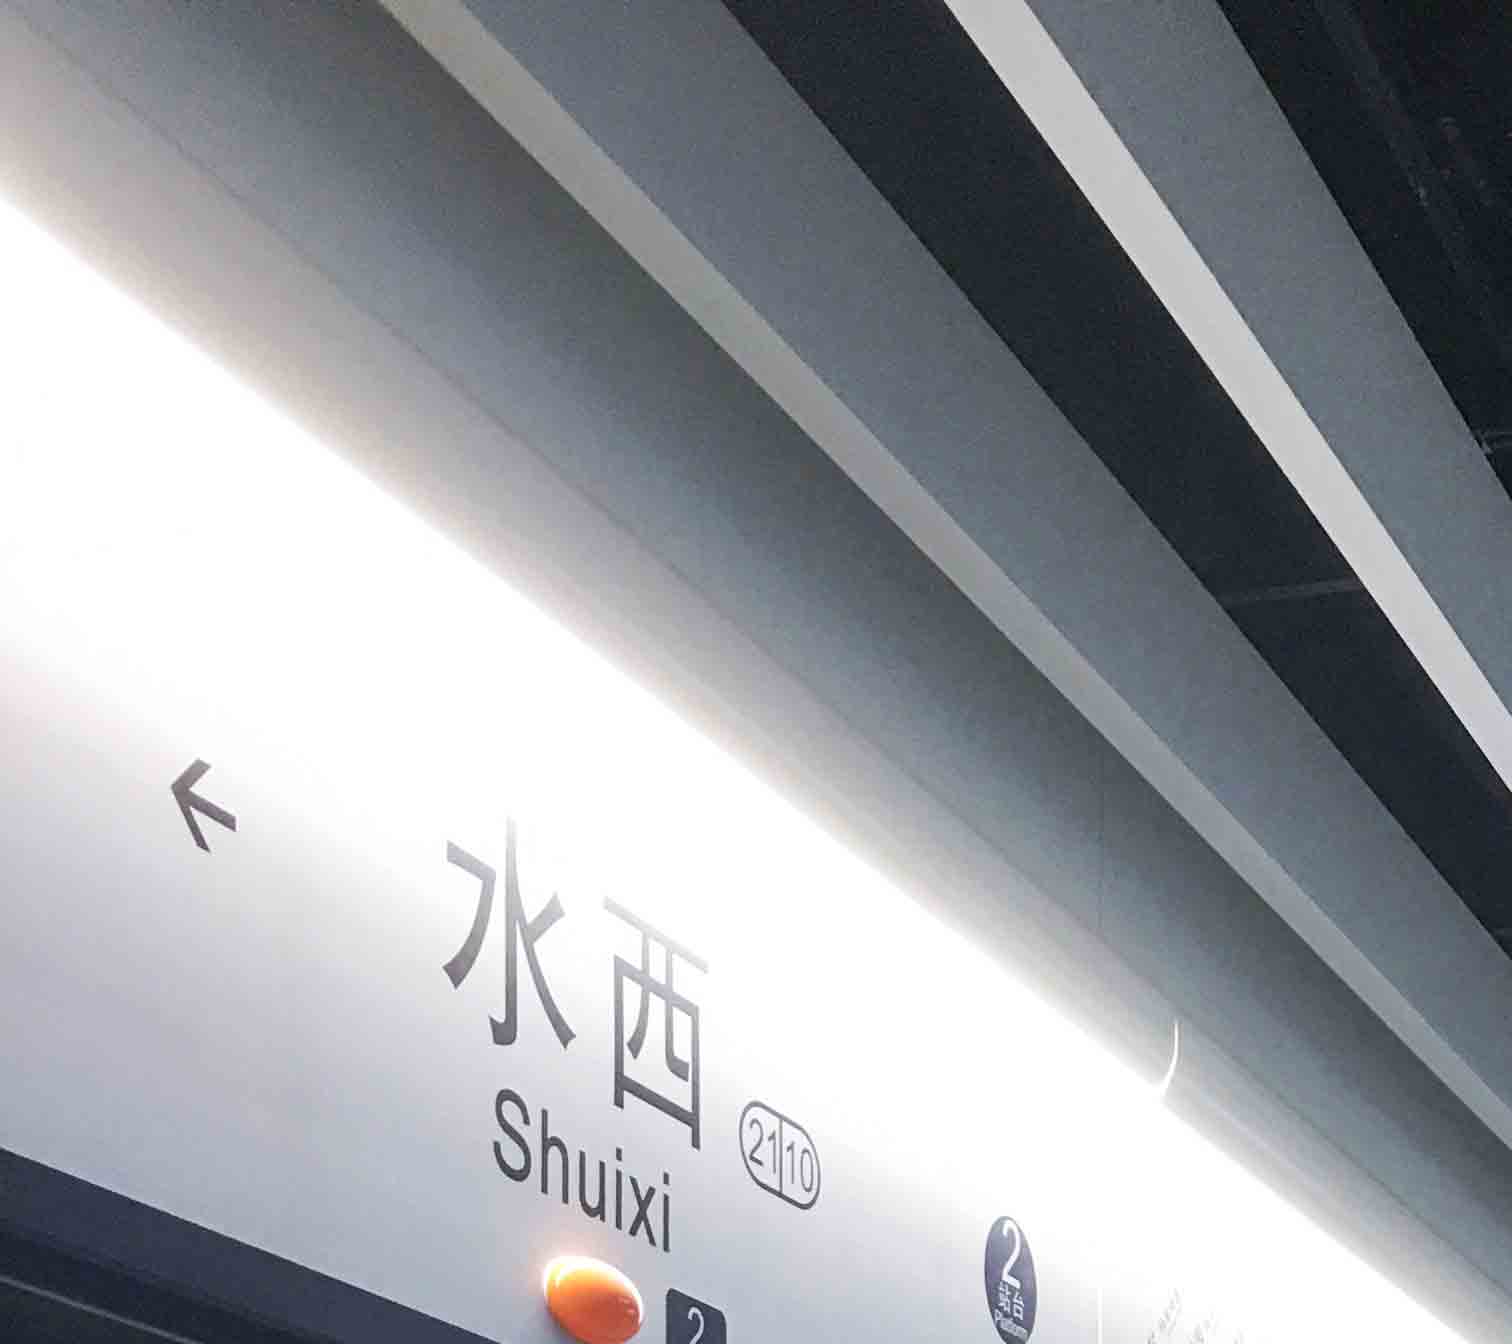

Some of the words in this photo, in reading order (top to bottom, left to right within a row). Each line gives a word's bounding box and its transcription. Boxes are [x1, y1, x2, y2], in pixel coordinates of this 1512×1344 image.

[441, 814, 709, 1151] 水西
[492, 1087, 673, 1253] Shuixi
[998, 1279, 1025, 1323] 站台
[1001, 1219, 1022, 1290] 2
